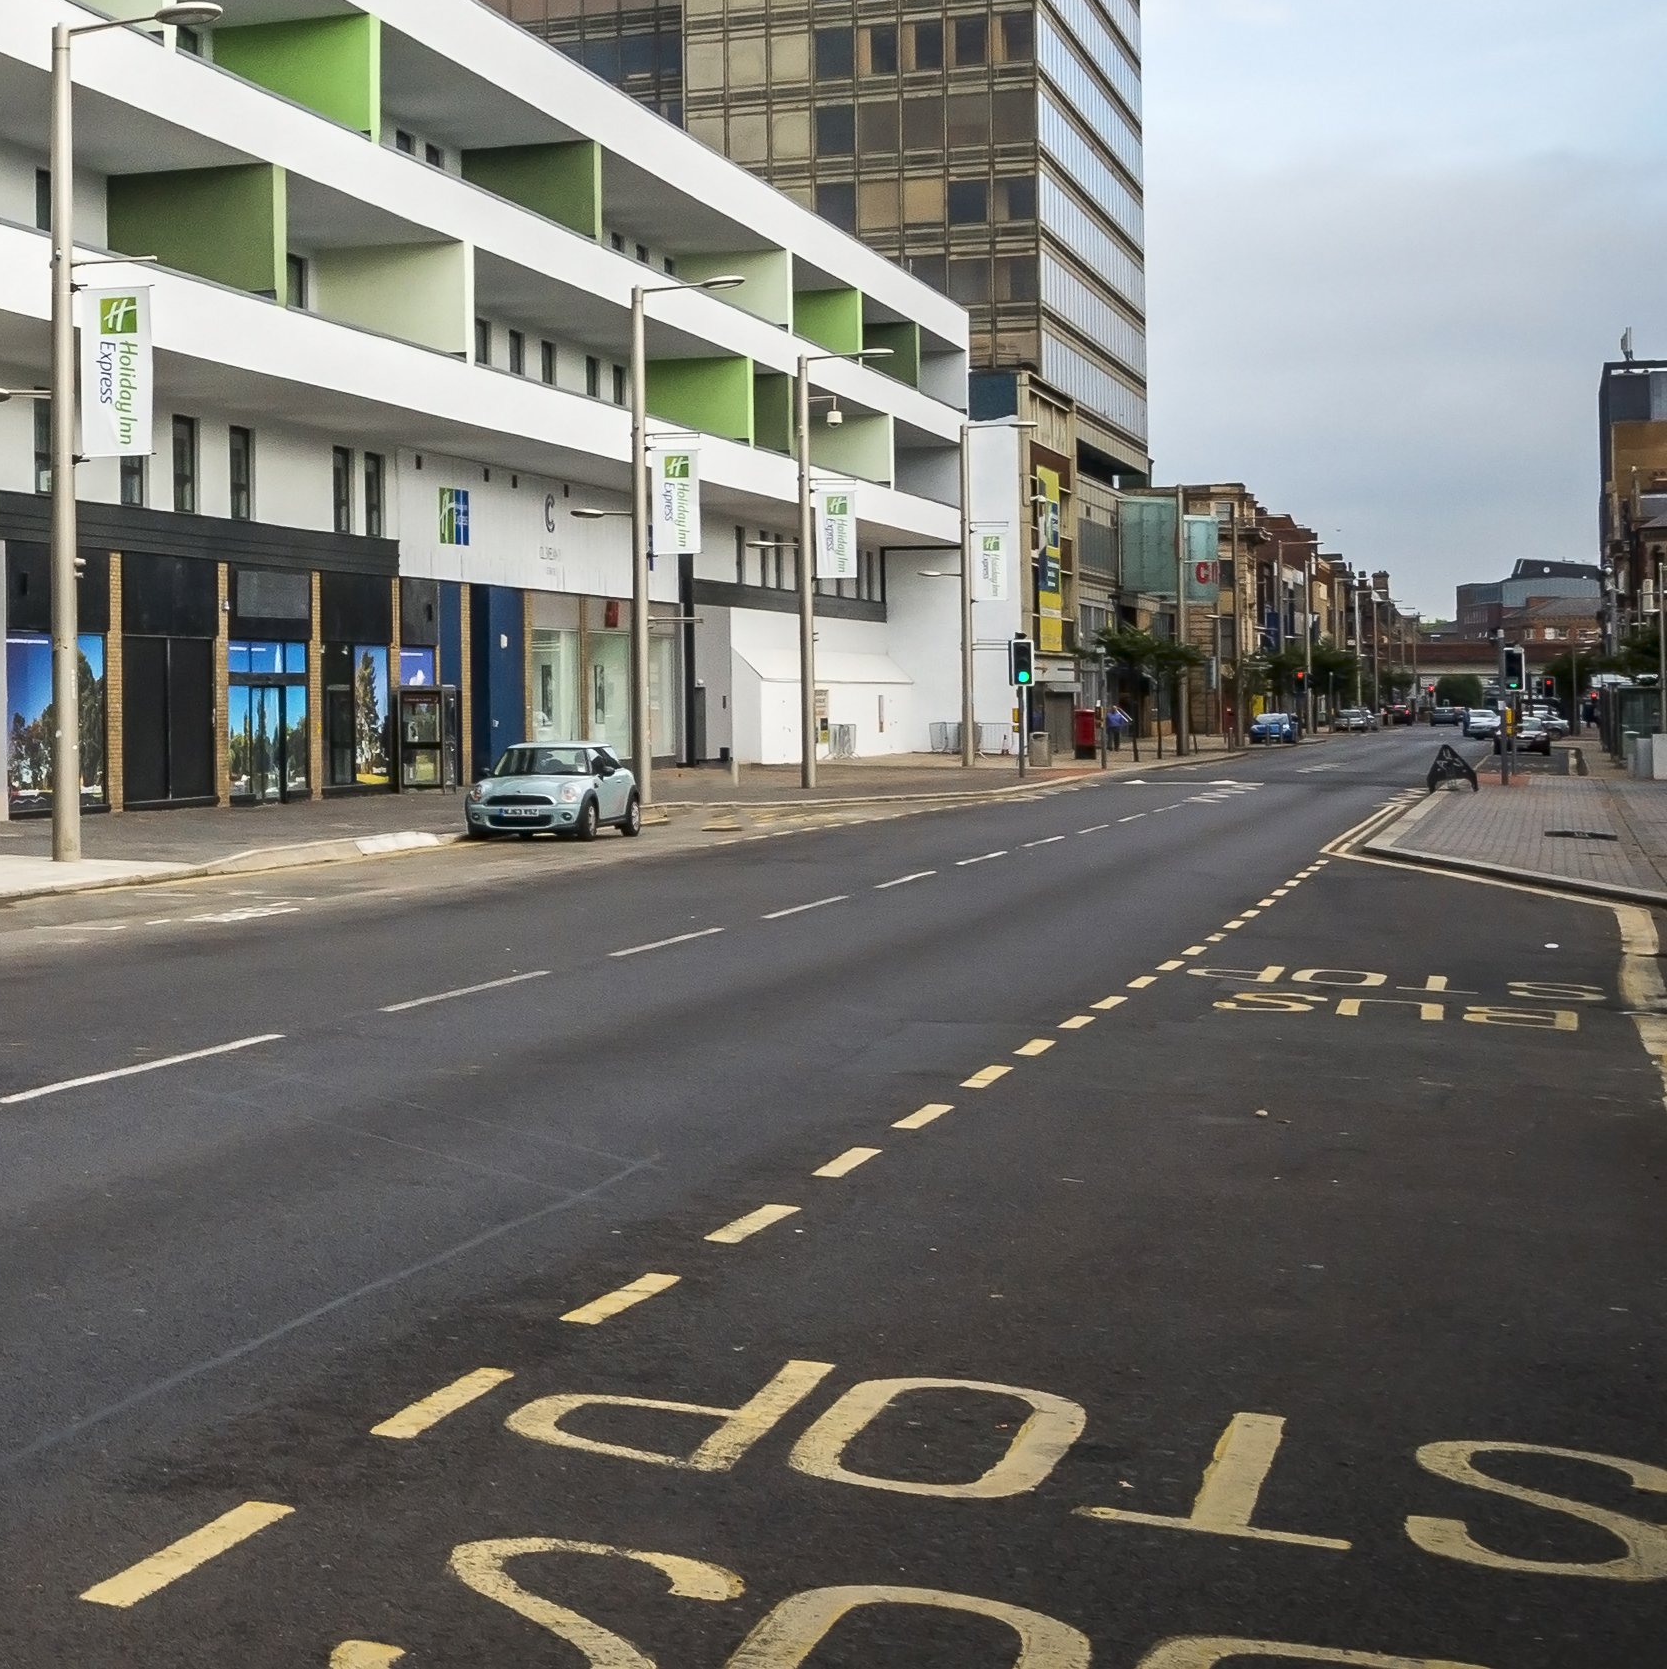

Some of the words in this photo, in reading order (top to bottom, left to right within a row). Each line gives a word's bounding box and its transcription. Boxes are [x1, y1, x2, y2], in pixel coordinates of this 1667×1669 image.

[95, 341, 116, 405] Express
[114, 340, 138, 413] Holiday
[120, 415, 138, 445] Inn
[662, 482, 675, 522] Express
[673, 482, 690, 527] Holiday
[678, 529, 690, 547] Inn
[1186, 965, 1607, 1001] STOP
[1212, 992, 1579, 1031] BUS
[504, 1360, 1667, 1582] STOP
